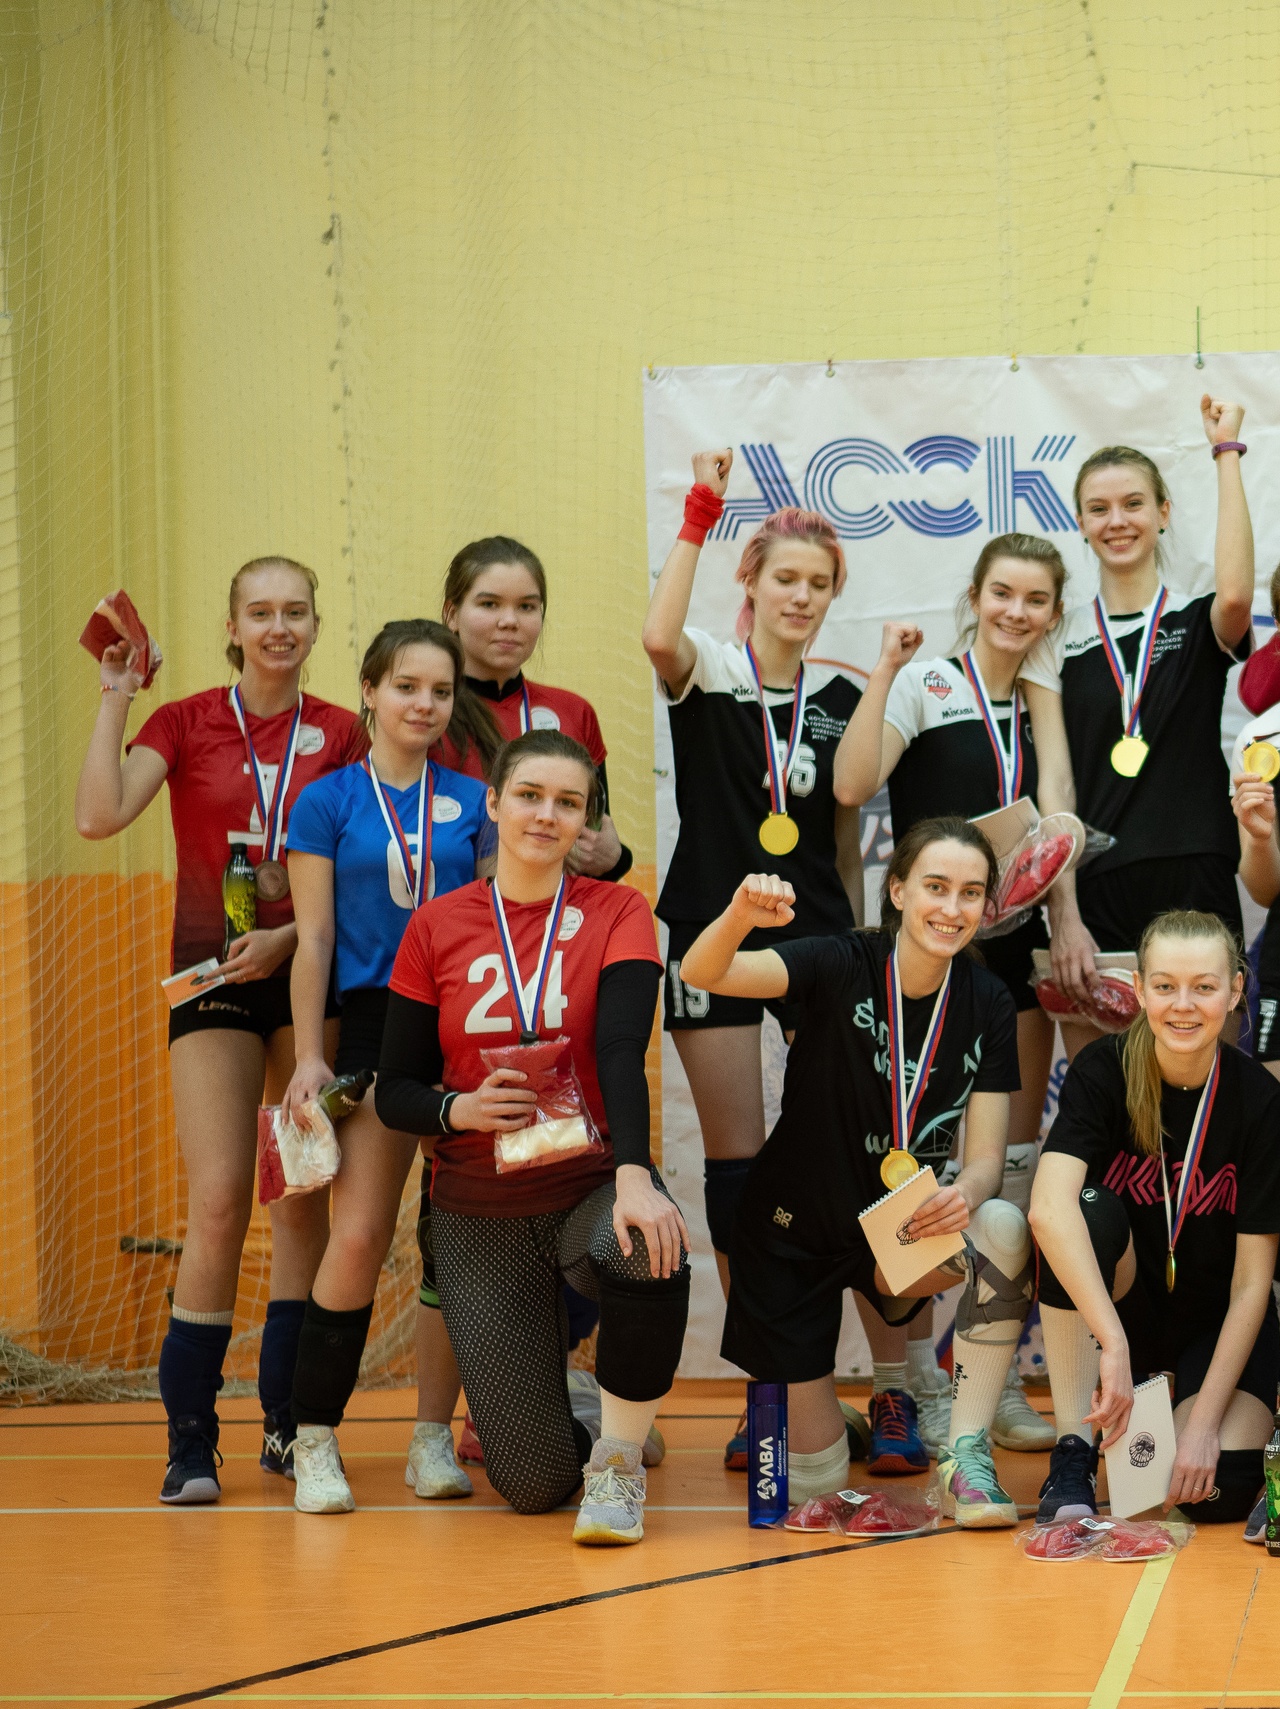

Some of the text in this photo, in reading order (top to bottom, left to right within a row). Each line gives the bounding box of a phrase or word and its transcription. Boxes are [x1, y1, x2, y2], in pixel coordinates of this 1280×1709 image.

[707, 434, 1079, 541] АССК
[386, 833, 436, 910] 6
[464, 950, 568, 1034] 24
